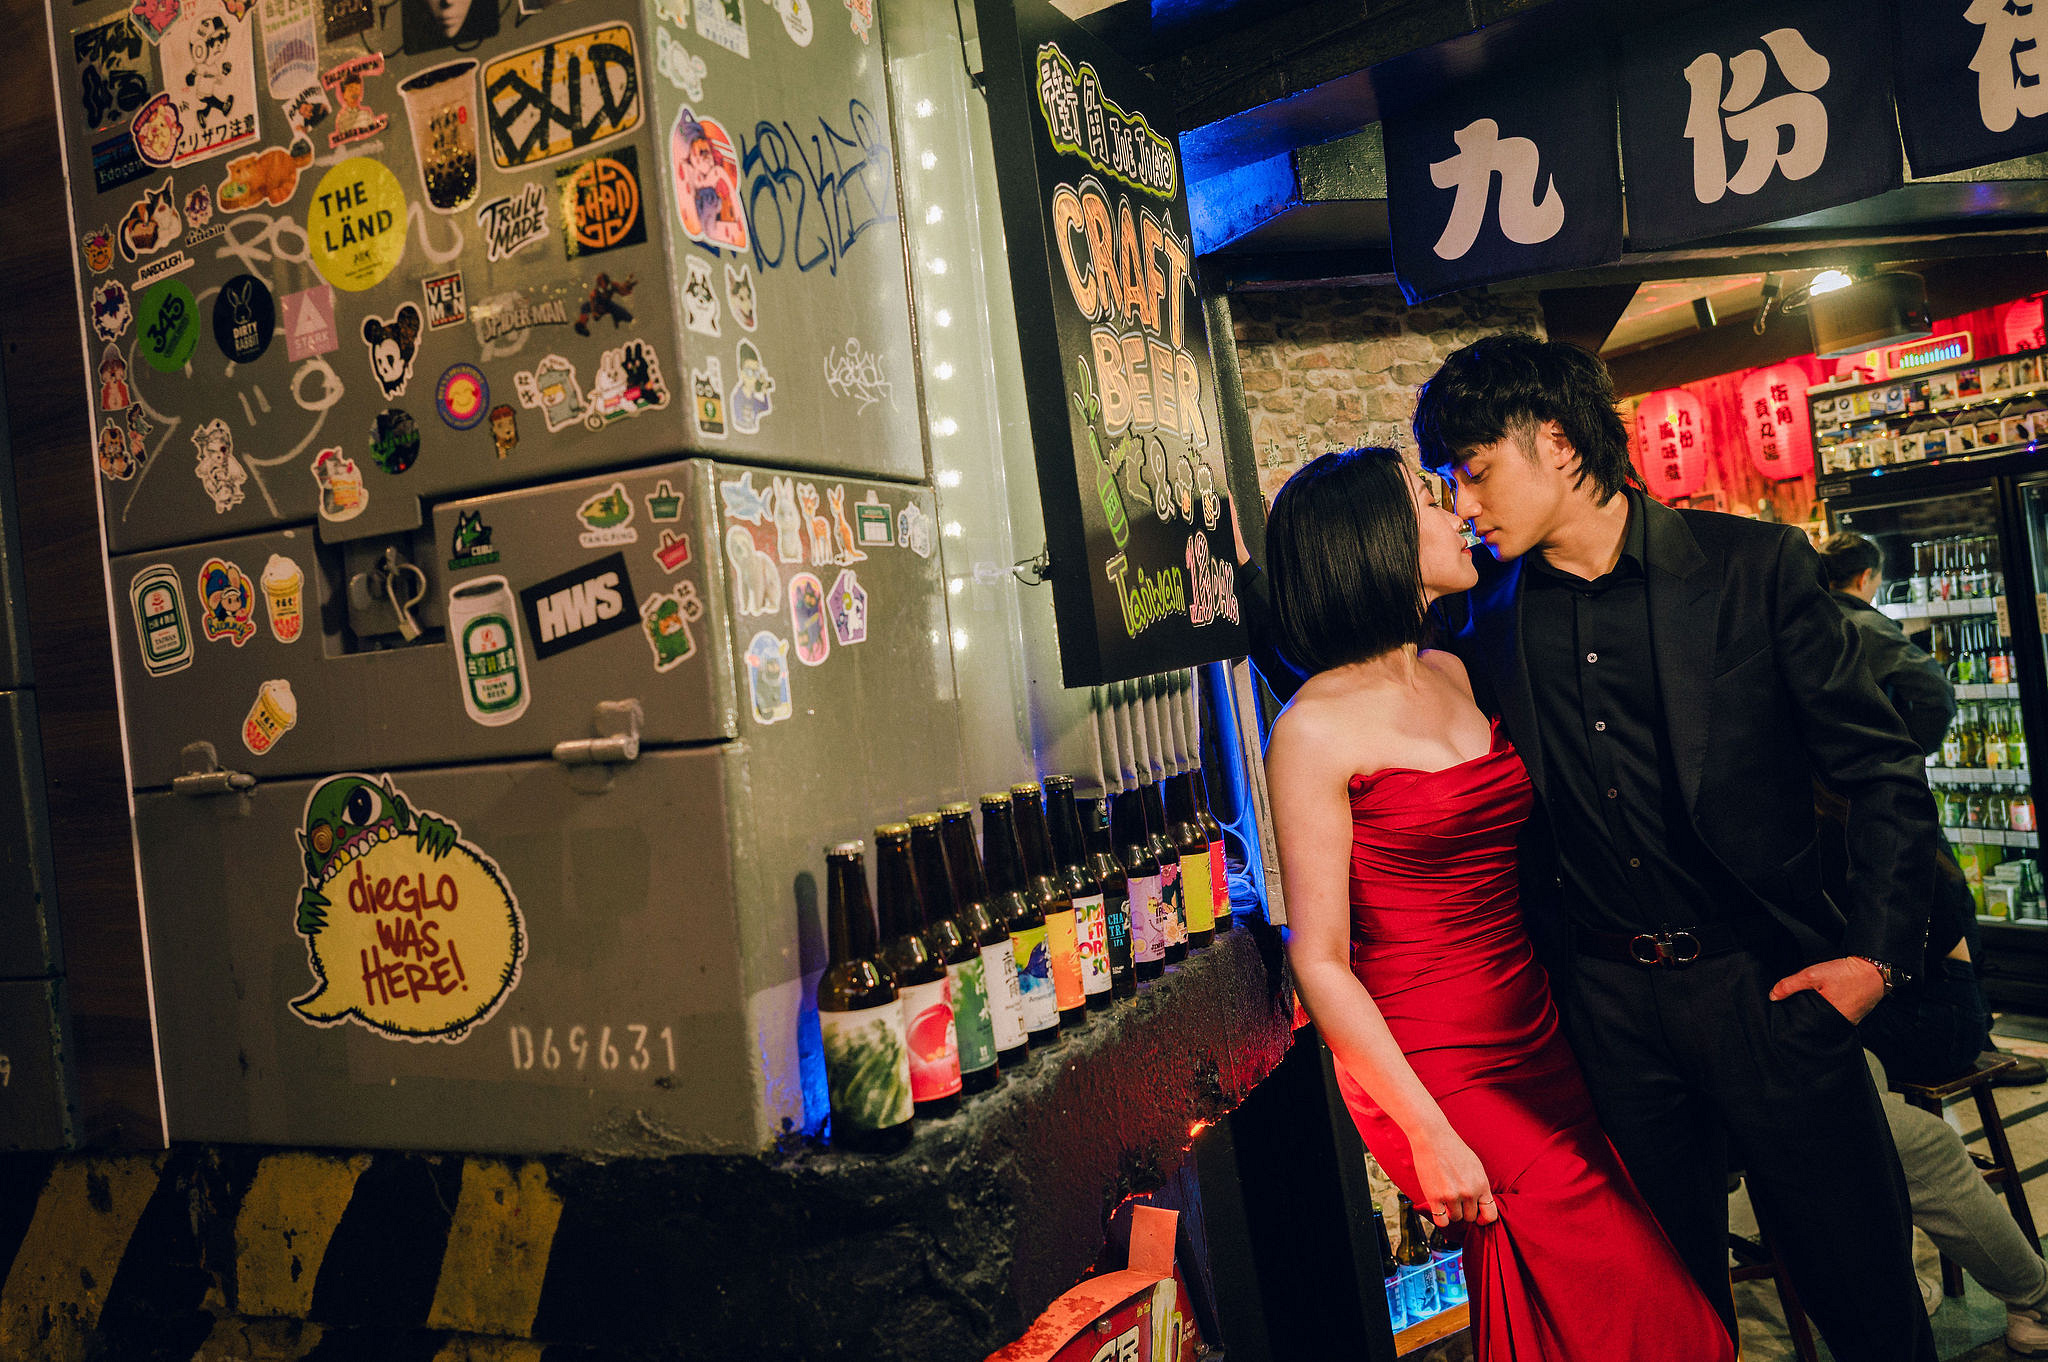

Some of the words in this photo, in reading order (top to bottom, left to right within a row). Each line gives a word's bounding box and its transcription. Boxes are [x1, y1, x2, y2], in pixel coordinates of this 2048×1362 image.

[319, 181, 368, 217] THE
[325, 209, 393, 253] LÄND
[492, 211, 545, 257] MADE
[427, 280, 463, 305] VEL
[1053, 191, 1188, 349] CRAFT
[147, 292, 186, 354] 345
[233, 320, 258, 336] DIRTY
[294, 332, 330, 350] STARK
[1091, 323, 1208, 447] BEER
[536, 572, 623, 643] HWS
[376, 916, 440, 961] WAS
[362, 939, 468, 1006] HERE!
[510, 1025, 676, 1072] D69631
